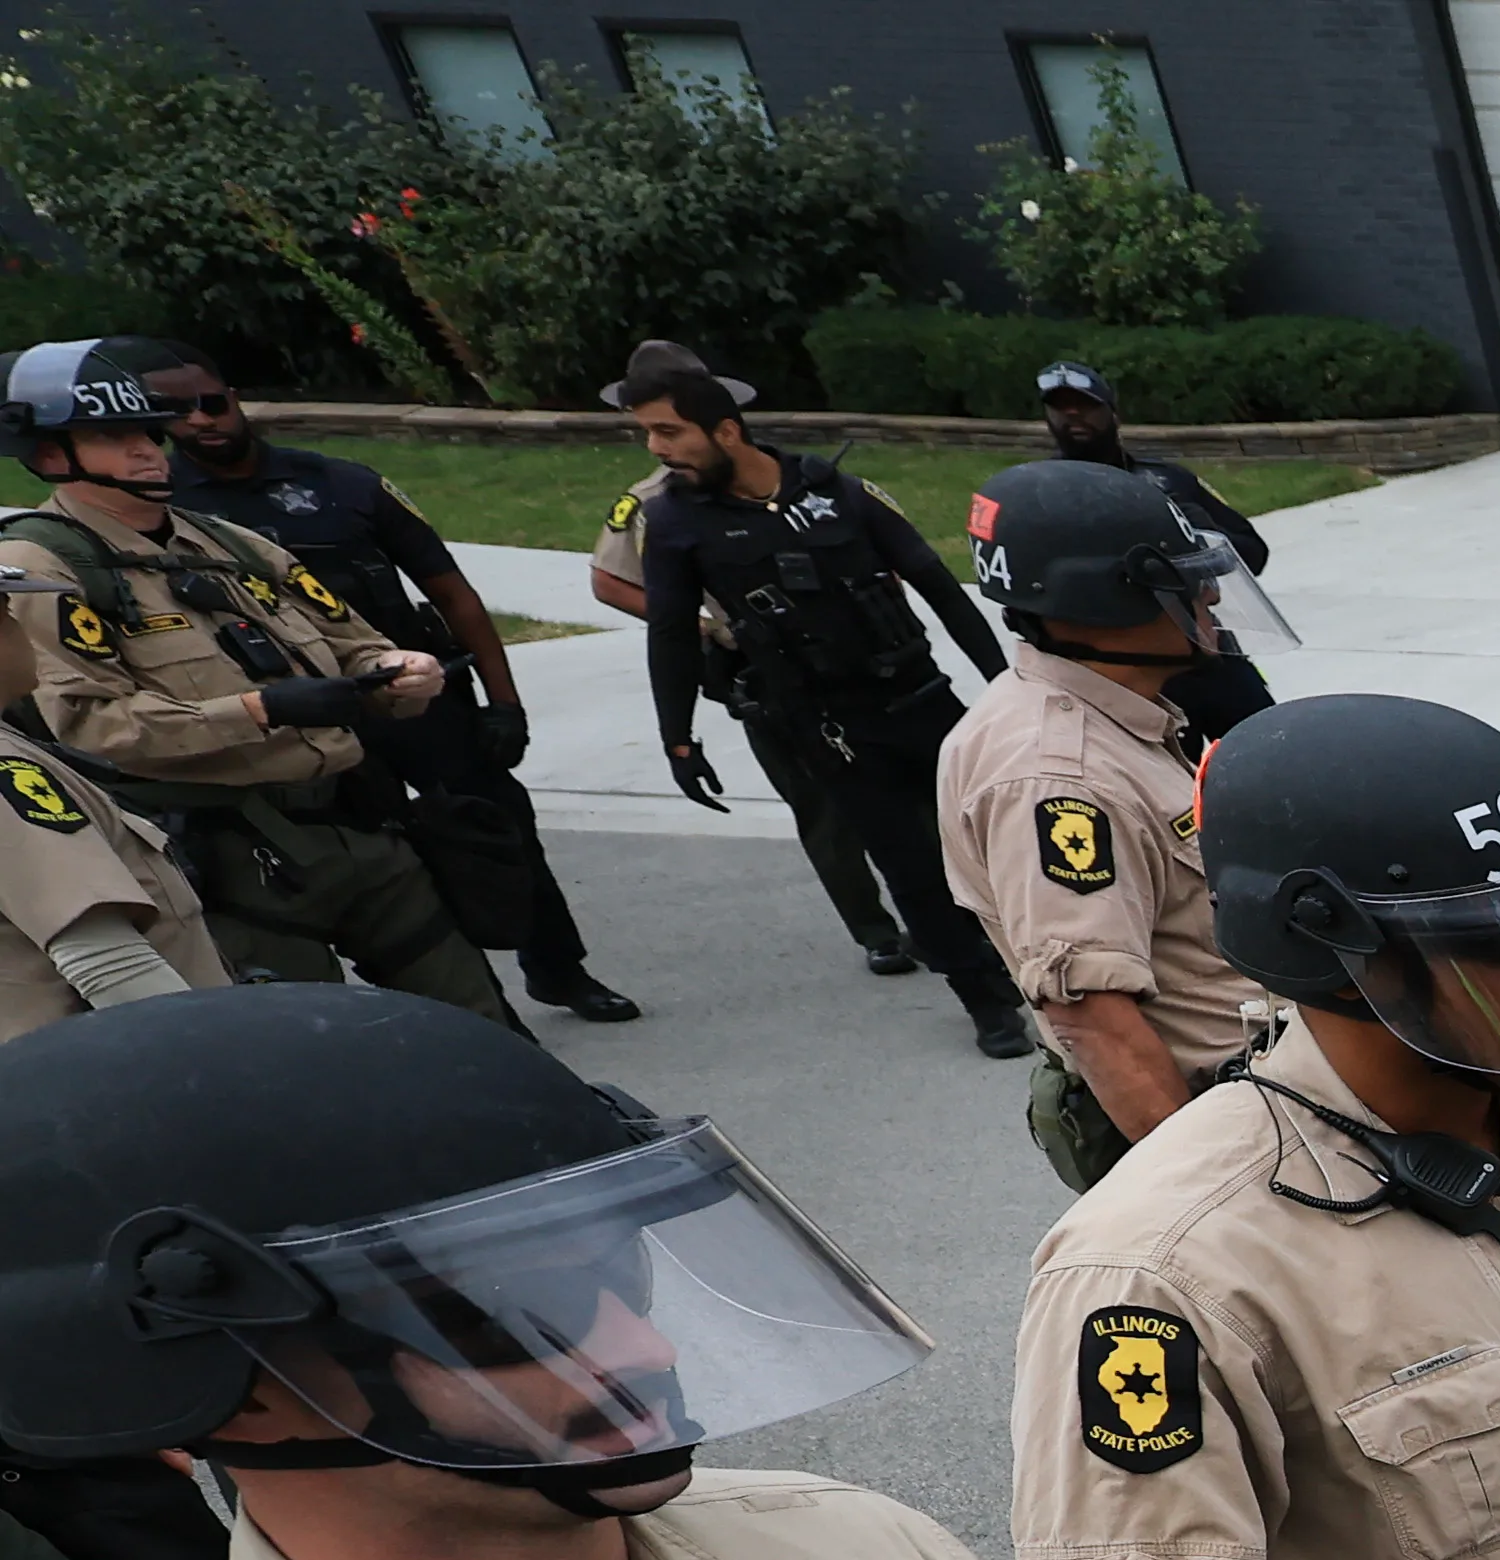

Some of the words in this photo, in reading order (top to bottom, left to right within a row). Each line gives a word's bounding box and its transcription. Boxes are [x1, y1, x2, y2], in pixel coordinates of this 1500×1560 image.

[1044, 803, 1098, 818] ILLINOIS
[1047, 864, 1079, 881] STATE
[1080, 867, 1111, 882] POLICE
[1092, 1315, 1180, 1340] ILLINOIS
[1089, 1424, 1135, 1452] STATE
[1138, 1427, 1195, 1453] POLICE
